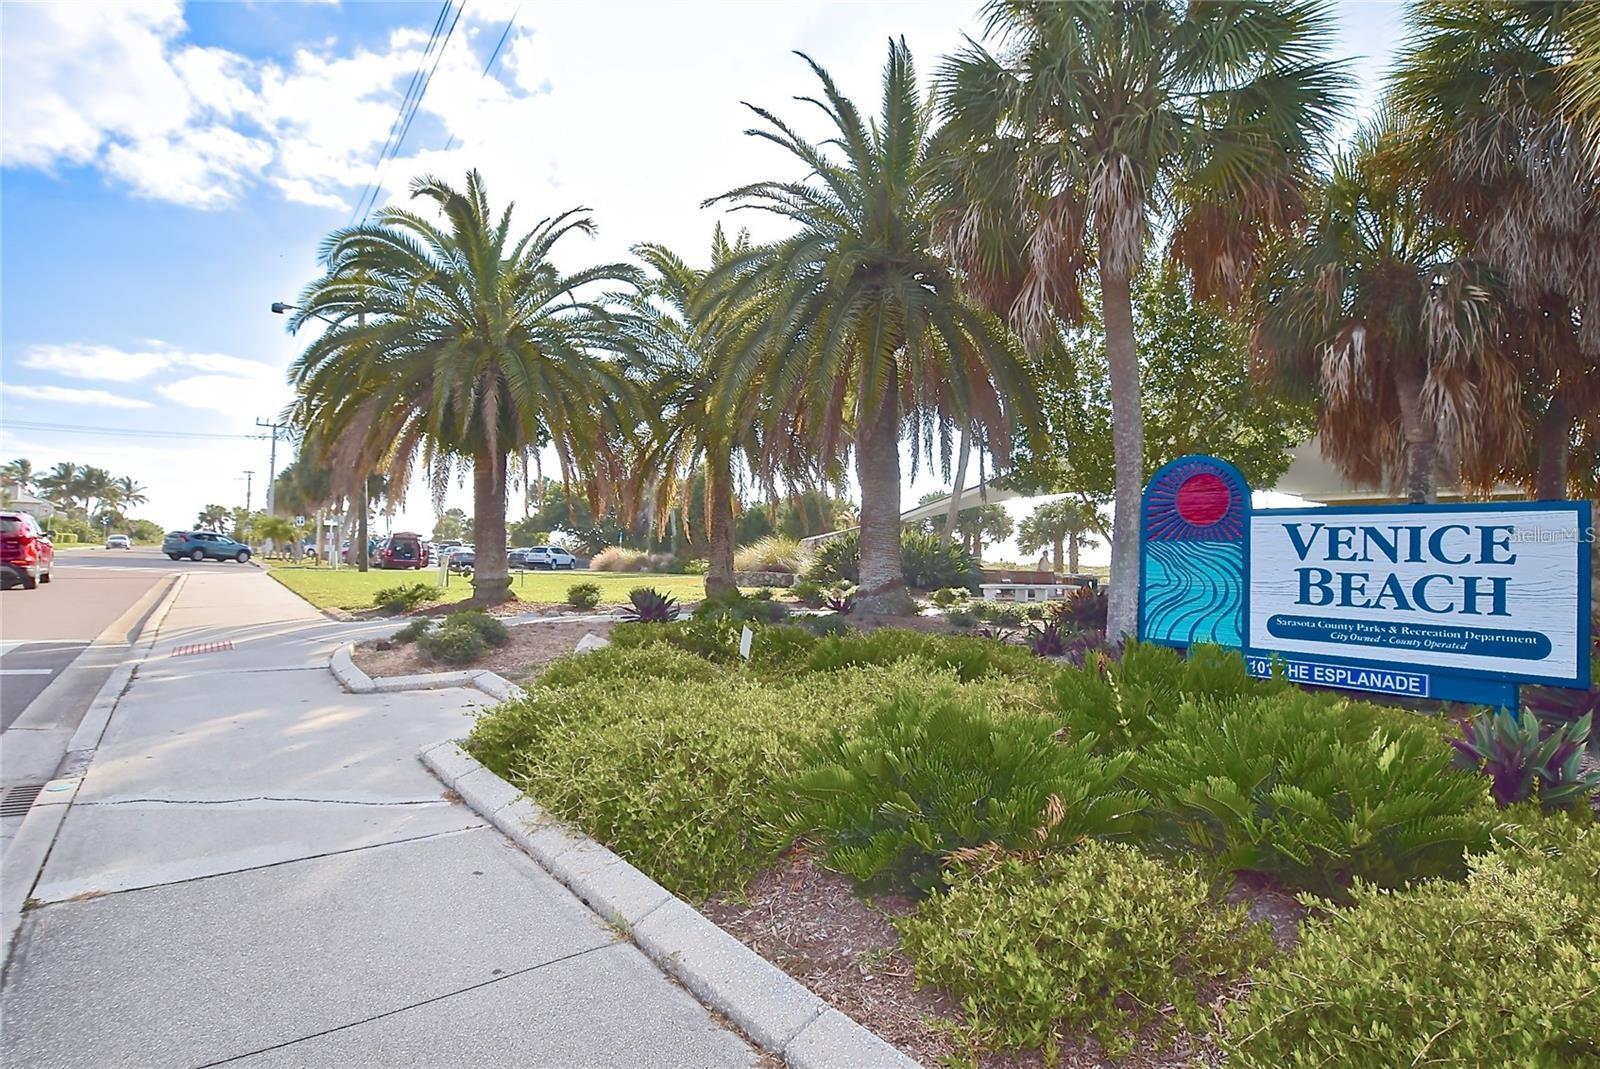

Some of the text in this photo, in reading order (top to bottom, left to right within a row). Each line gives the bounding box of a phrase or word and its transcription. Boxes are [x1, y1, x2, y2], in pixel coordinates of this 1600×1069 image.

[1281, 523, 1517, 565] VENICE
[1294, 567, 1512, 616] BEACH
[1276, 618, 1537, 645] Sarasota County Parks & Recreation Department
[1330, 632, 1348, 642] City
[1350, 633, 1381, 643] Owned
[1389, 636, 1421, 647] County
[1423, 640, 1468, 651] Operated
[1278, 662, 1309, 680] HE
[1314, 667, 1420, 692] ESPLANADE
